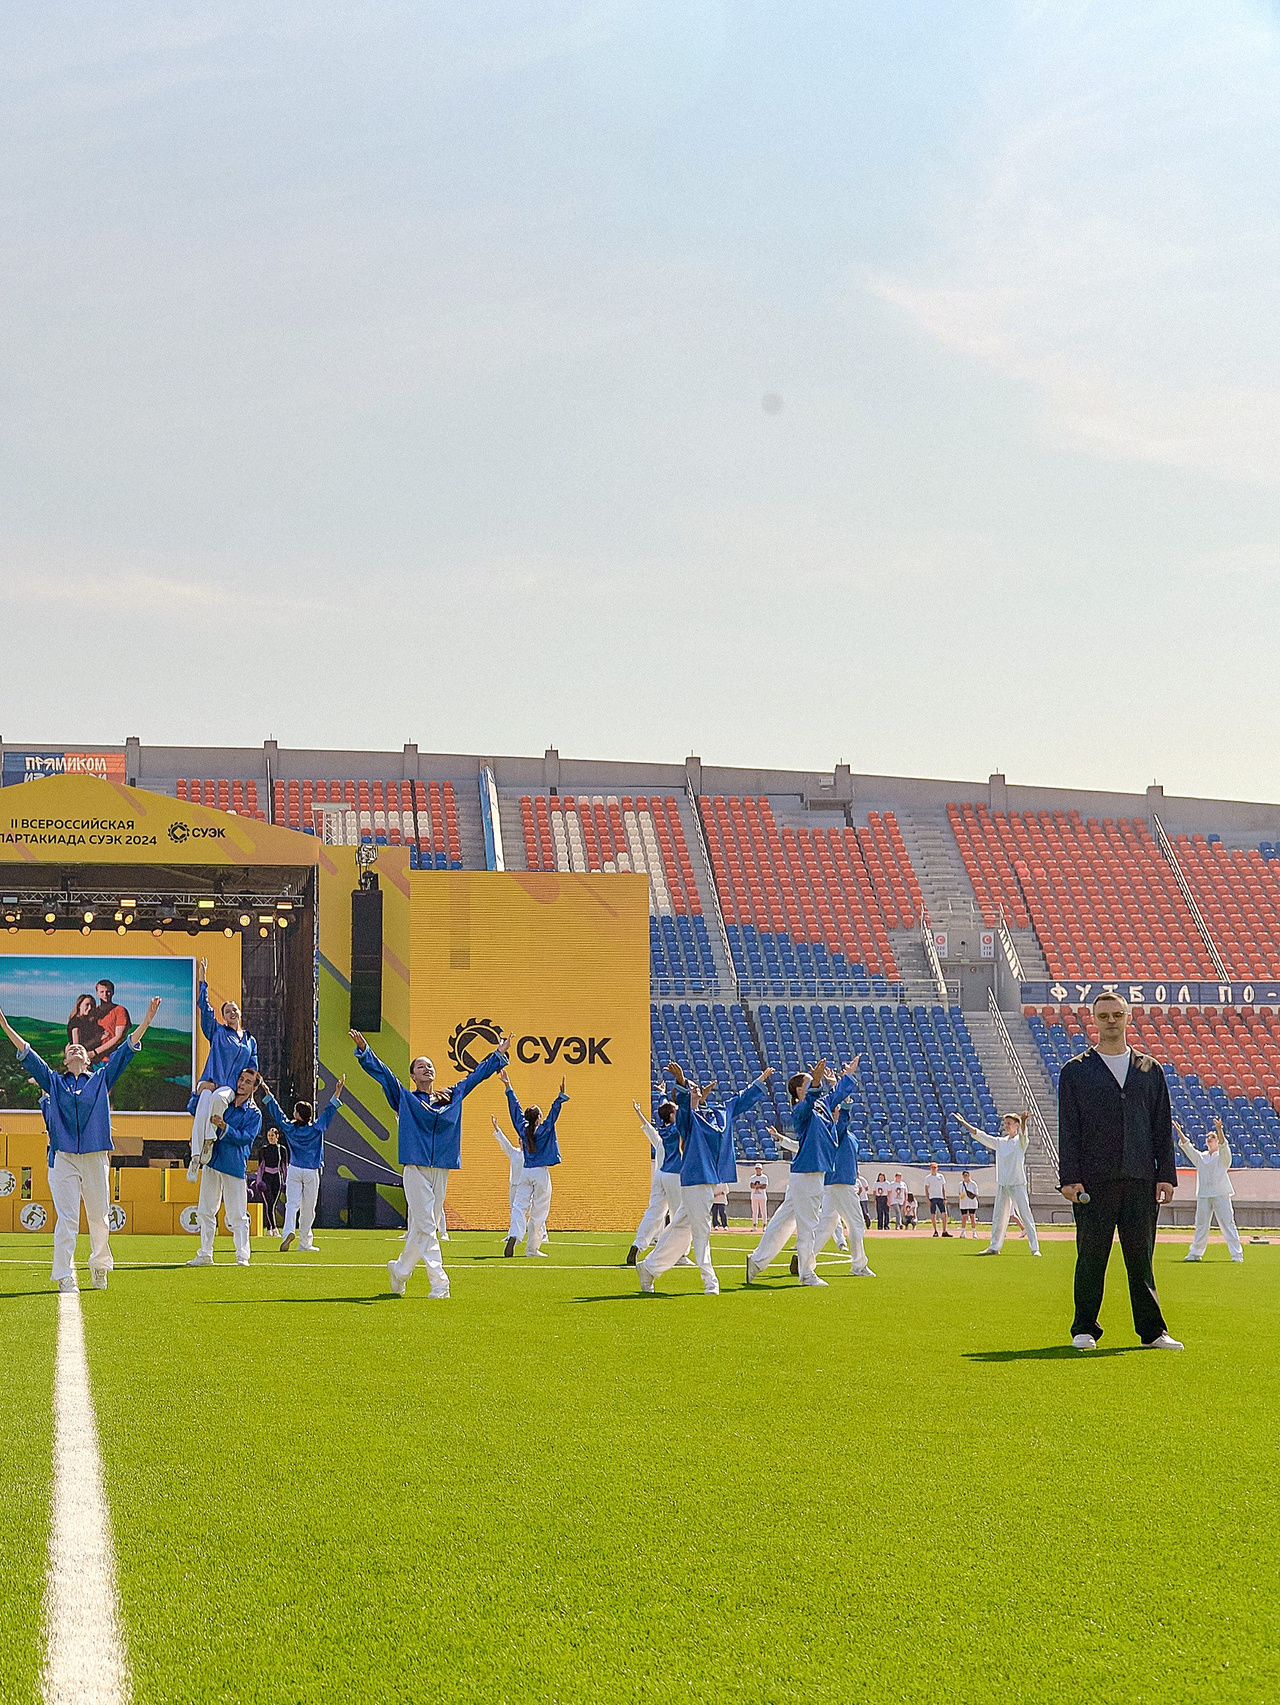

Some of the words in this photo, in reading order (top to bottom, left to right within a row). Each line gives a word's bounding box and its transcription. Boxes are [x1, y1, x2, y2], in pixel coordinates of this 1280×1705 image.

[24, 755, 107, 771] ПРЯМИКОМ
[10, 819, 19, 830] II
[21, 817, 135, 830] ВСЕРОССИЙСКАЯ
[192, 827, 226, 839] СУЭК
[88, 834, 123, 846] СУЭК
[125, 834, 158, 846] 2024
[516, 1035, 613, 1065] СУЭК
